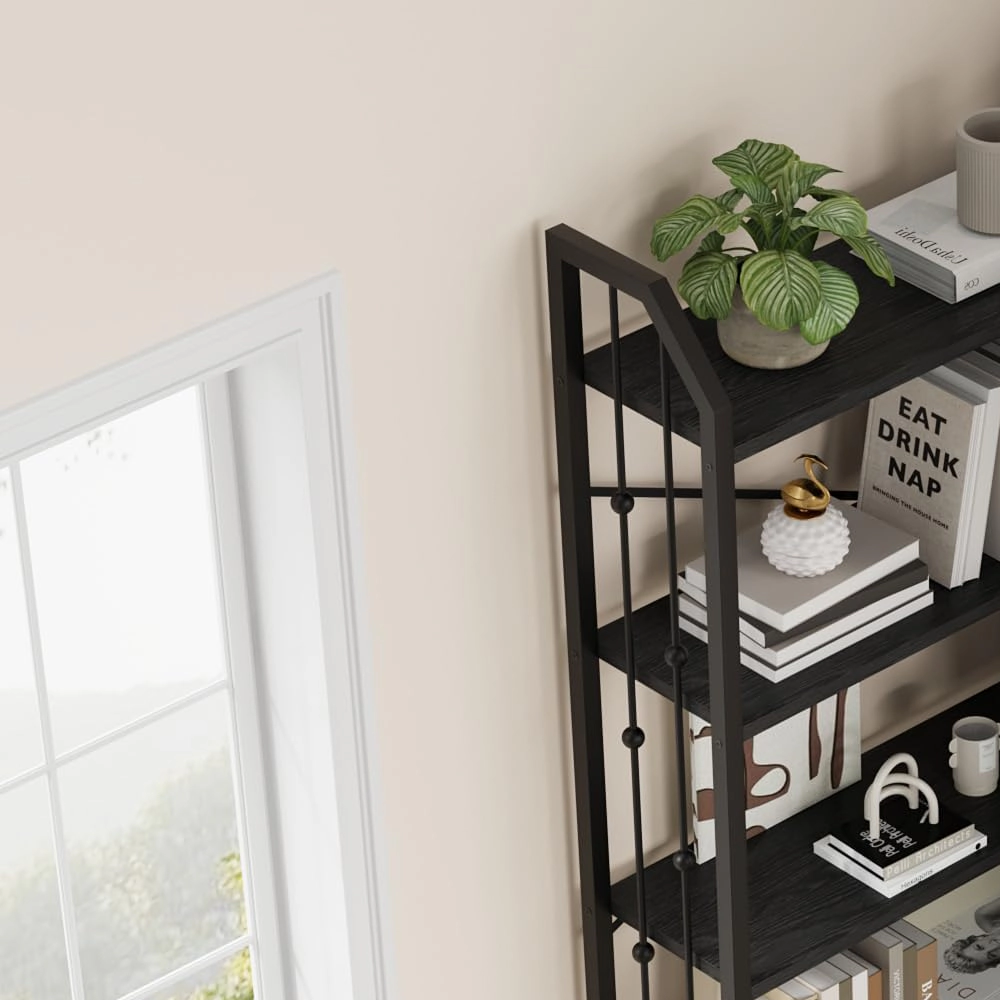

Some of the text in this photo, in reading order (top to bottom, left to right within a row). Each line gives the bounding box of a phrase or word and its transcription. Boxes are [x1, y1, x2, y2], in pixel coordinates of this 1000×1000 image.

[899, 396, 947, 436] EAT
[877, 417, 960, 479] DRINK
[887, 455, 942, 499] NAP
[872, 485, 950, 531] BRINGING THE HOUSE HOME
